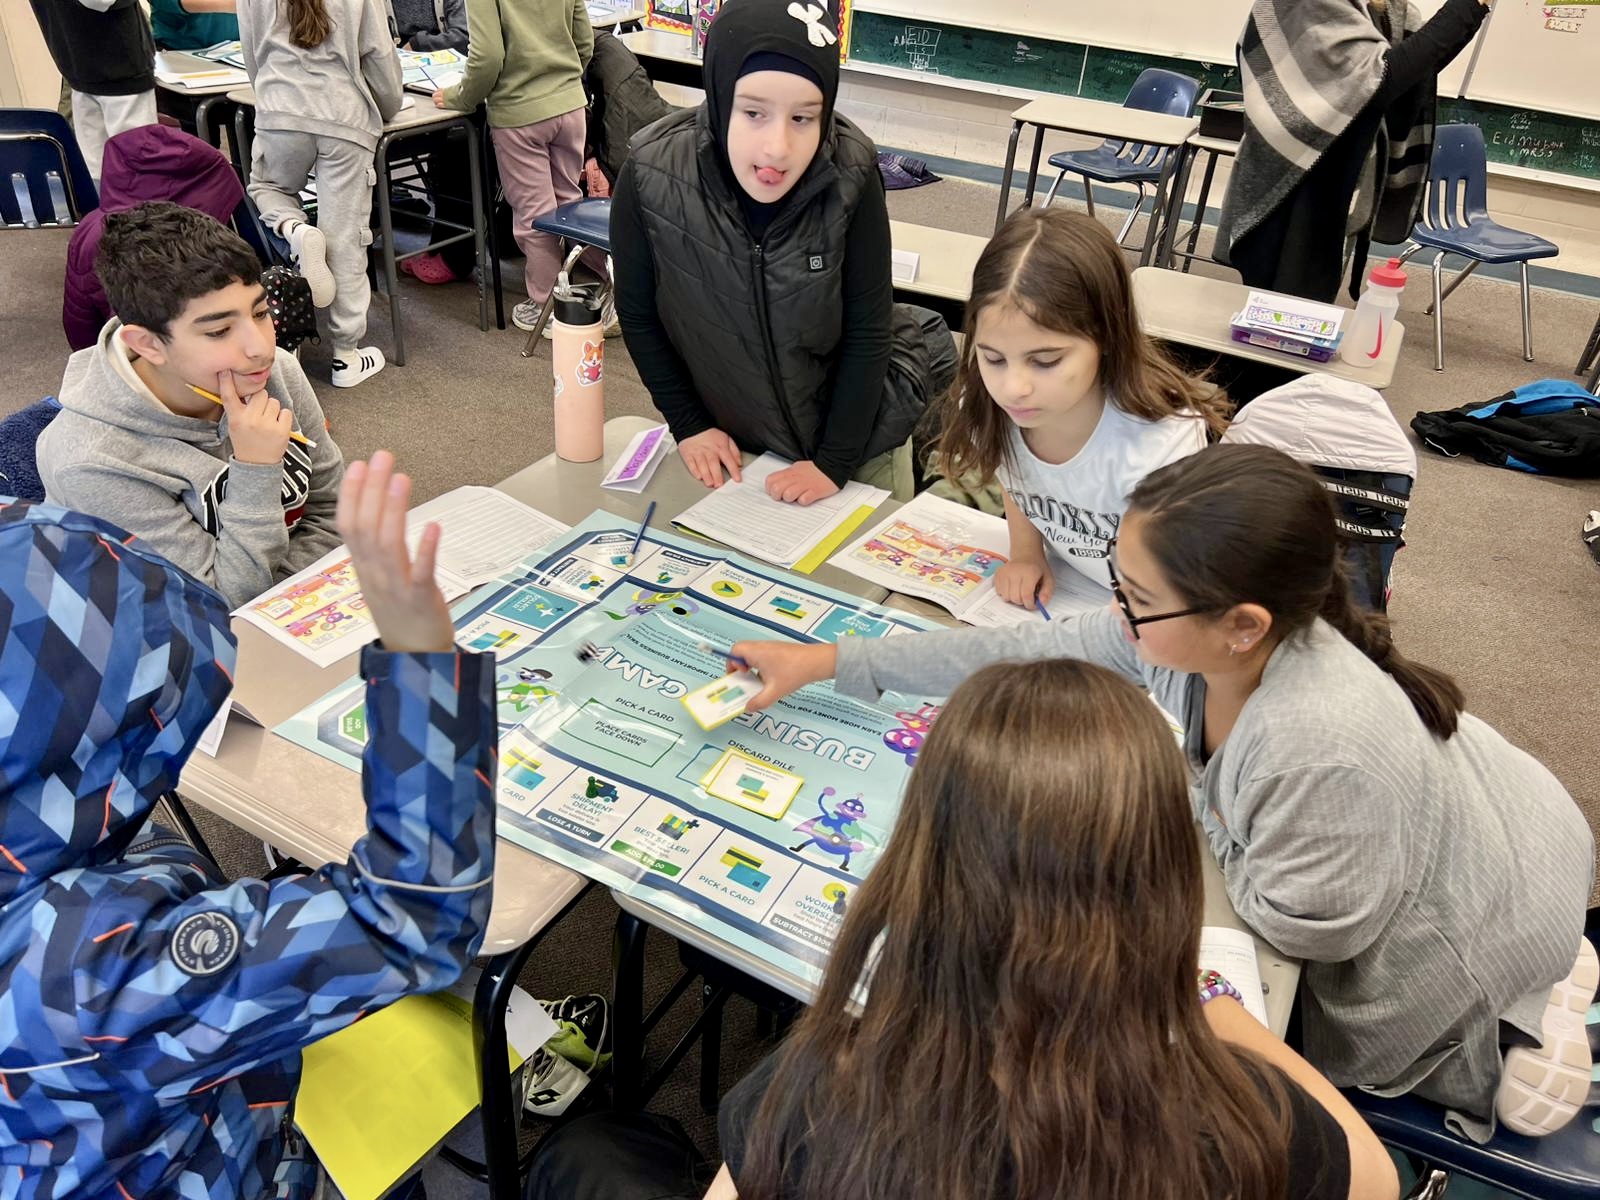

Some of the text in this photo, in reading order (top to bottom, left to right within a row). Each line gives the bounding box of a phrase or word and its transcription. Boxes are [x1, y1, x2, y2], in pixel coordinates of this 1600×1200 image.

[1008, 488, 1121, 541] ROOKLY
[1043, 526, 1077, 545] New
[640, 643, 671, 660] BUSINESS
[669, 657, 709, 676] IMPORTANT
[615, 697, 636, 710] PICK
[647, 709, 675, 723] CARD
[777, 699, 882, 736] EARN MORE MONEY FOR YOUR
[594, 726, 642, 747] FACE DOWN
[596, 720, 649, 744] PLACE CARDS
[733, 711, 877, 772] BUSINE
[727, 739, 771, 763] DISCARD
[772, 757, 796, 772] PILE
[570, 793, 615, 814] SHIPMENT
[547, 815, 566, 826] LOSE
[571, 826, 592, 837] TURN
[633, 826, 656, 840] BEST
[698, 875, 756, 906] PICK A CARD
[805, 895, 835, 913] WORK
[773, 917, 816, 940] SUBTRACT
